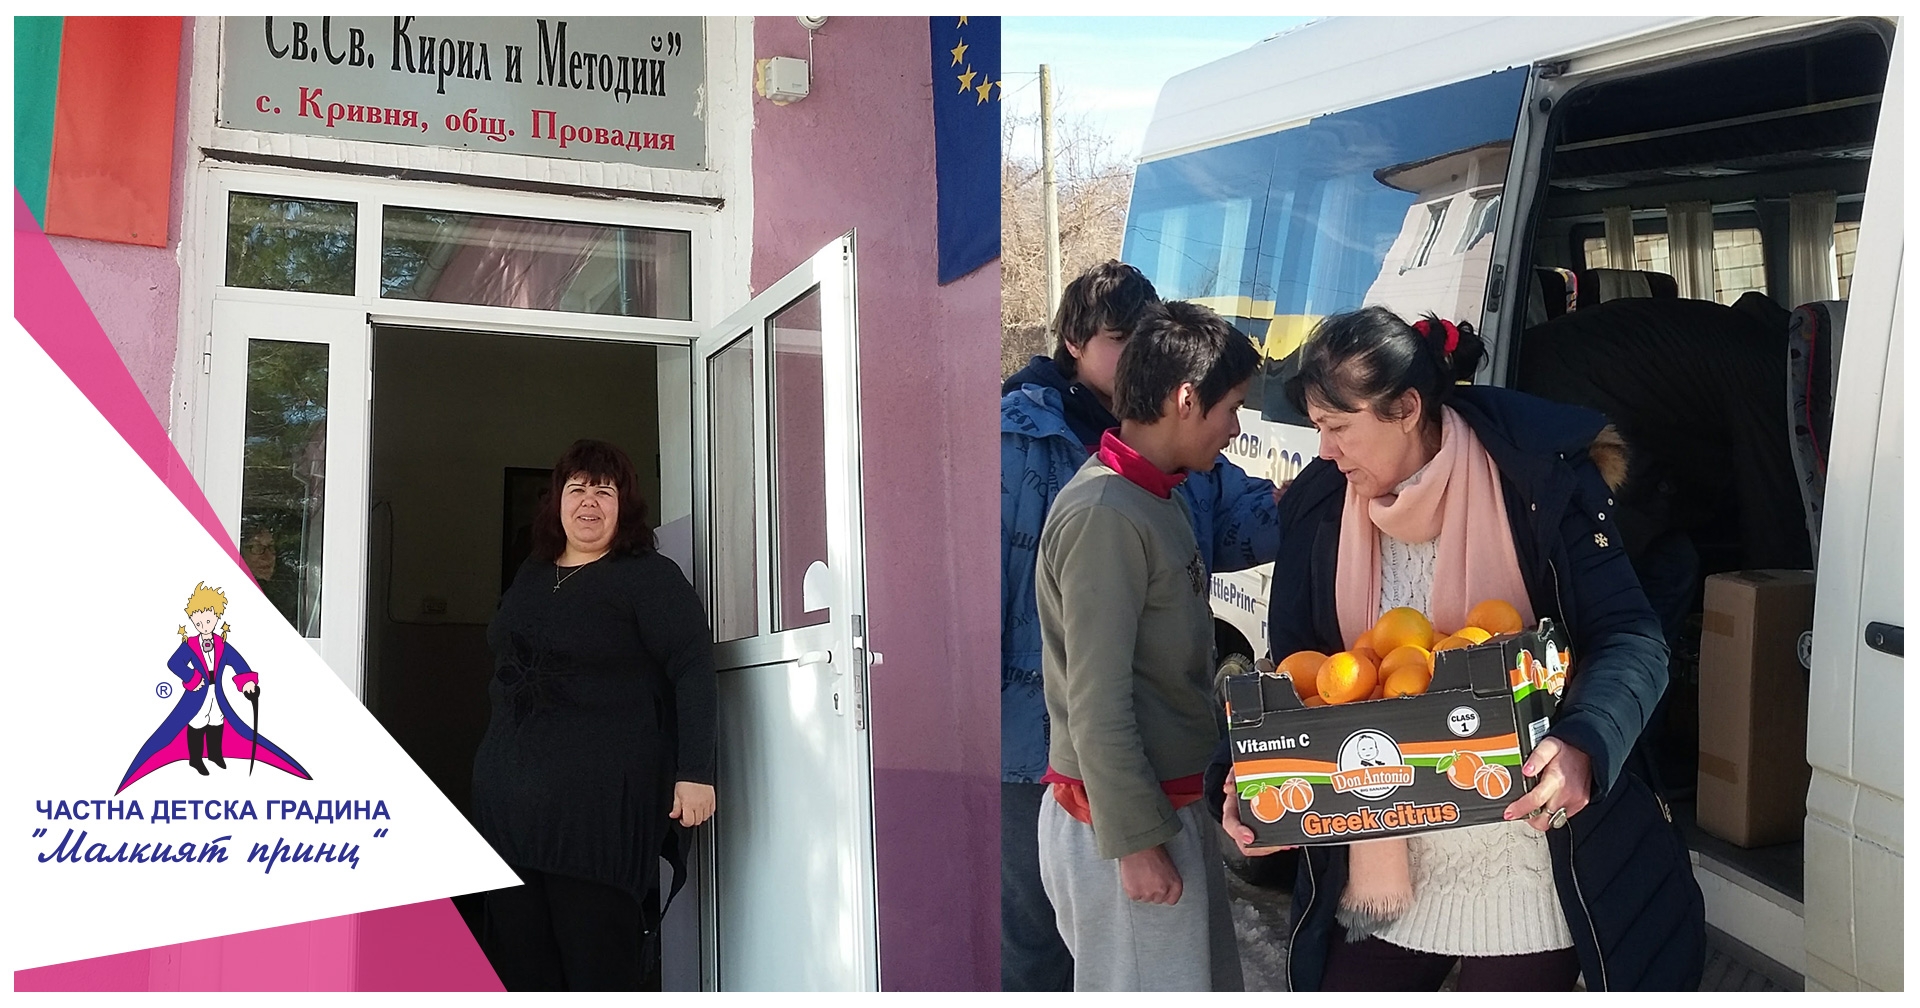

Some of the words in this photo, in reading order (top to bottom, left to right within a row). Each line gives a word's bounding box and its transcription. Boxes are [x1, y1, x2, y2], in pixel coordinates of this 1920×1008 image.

[391, 16, 492, 94] Кирил
[505, 45, 523, 83] и
[256, 95, 281, 114] с.
[298, 87, 429, 133] Кривня,
[445, 108, 515, 142] общ.
[531, 110, 676, 152] Провадия
[1451, 713, 1476, 723] CLASS
[1461, 723, 1470, 733] 1
[1237, 735, 1296, 754] Vitamin
[1299, 733, 1310, 747] C
[1334, 774, 1360, 790] Don
[1363, 768, 1410, 785] Antonio
[1302, 806, 1382, 837] Greek
[1383, 802, 1459, 828] citrus
